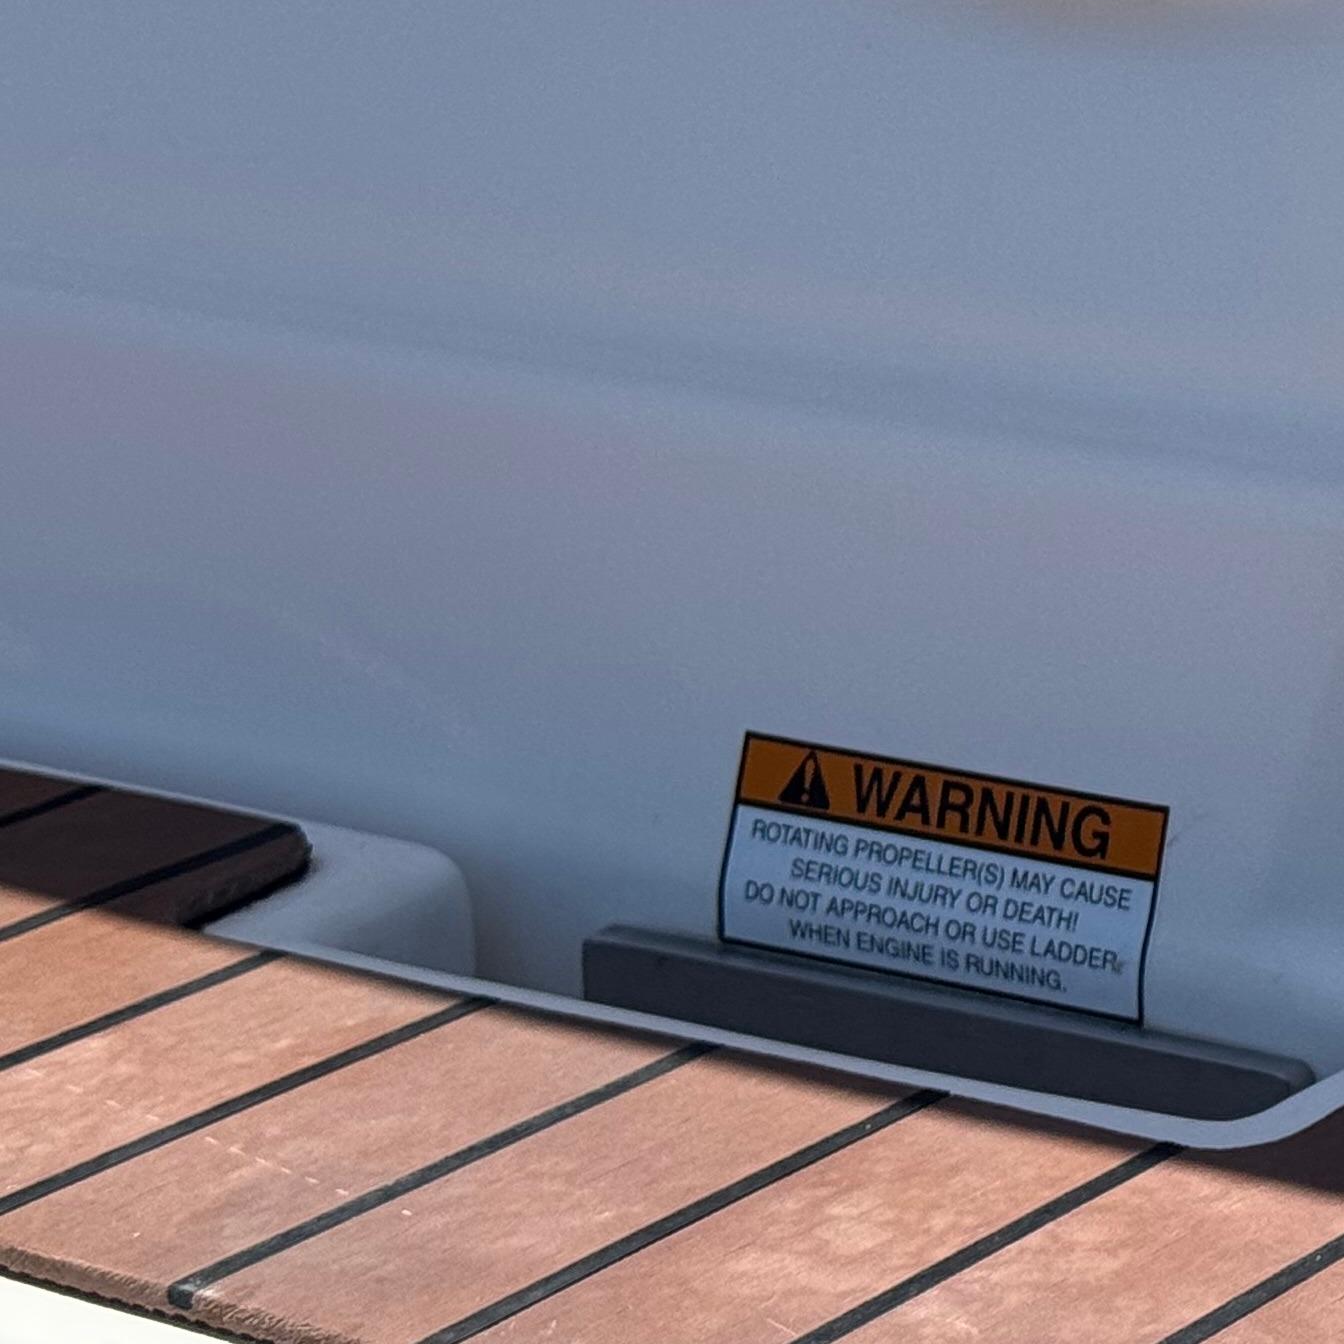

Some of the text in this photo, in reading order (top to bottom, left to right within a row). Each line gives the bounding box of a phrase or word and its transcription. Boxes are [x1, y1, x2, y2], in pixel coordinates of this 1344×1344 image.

[853, 762, 1112, 859] WARNING
[752, 818, 1133, 911] ROTATING PROPELLER(S) MAY CAUSE
[790, 858, 1080, 933] SERIOUS INJURY OR DEATH!
[745, 879, 775, 905] DO
[780, 887, 822, 915] NOT
[825, 896, 940, 937] APPROACH
[945, 919, 977, 944] OR
[982, 925, 1026, 954] USE
[789, 918, 1067, 993] WHEN ENGINE IS RUNNING.
